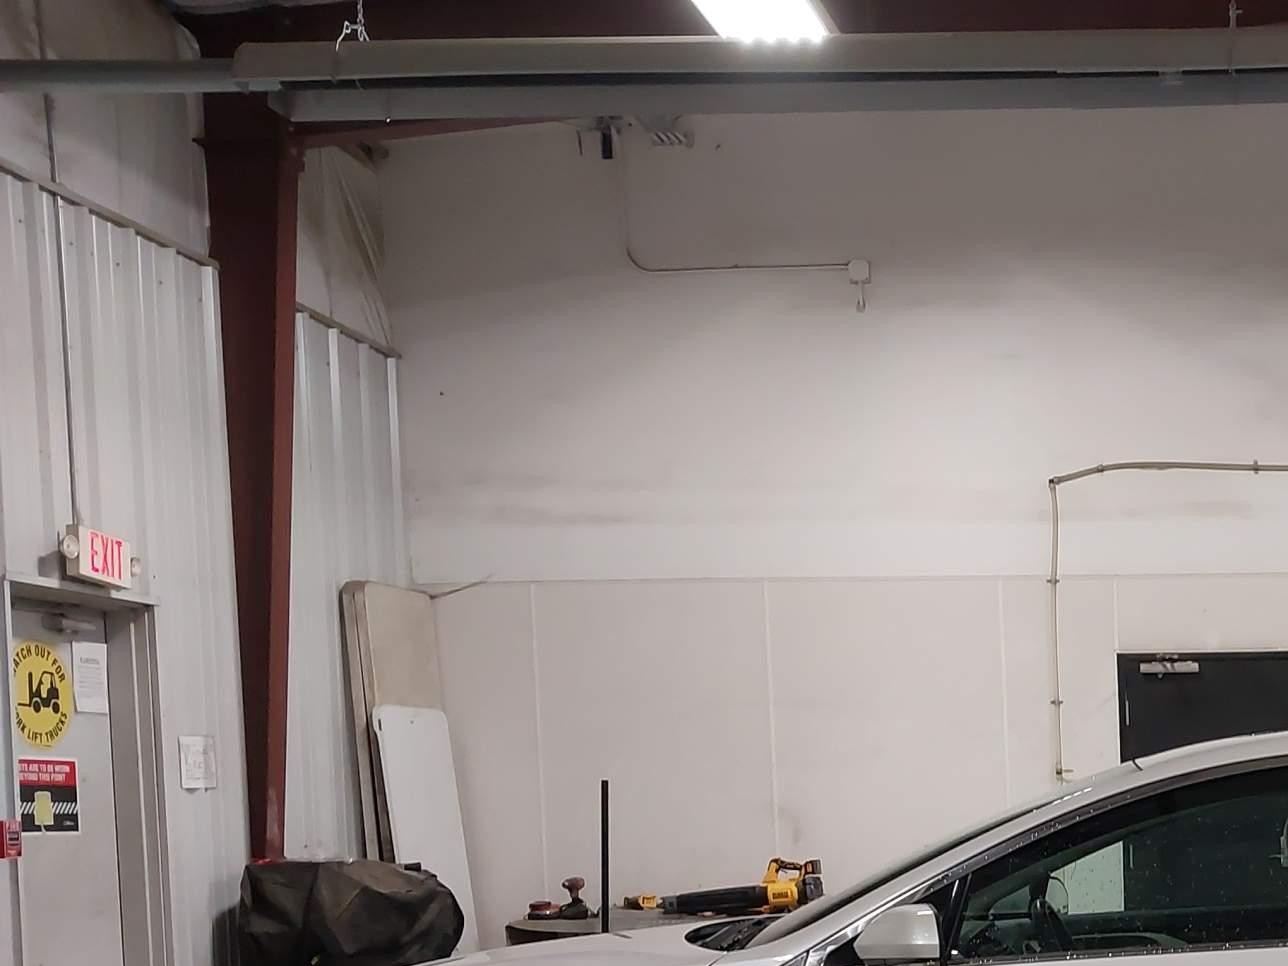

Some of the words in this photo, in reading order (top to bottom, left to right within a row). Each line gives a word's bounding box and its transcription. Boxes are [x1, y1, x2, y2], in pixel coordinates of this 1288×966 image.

[89, 531, 123, 580] EXIT
[12, 645, 32, 673] ATCH
[34, 644, 51, 661] OUT
[51, 657, 66, 684] FOR
[27, 728, 43, 743] LIFT
[44, 711, 68, 743] TRUCKS
